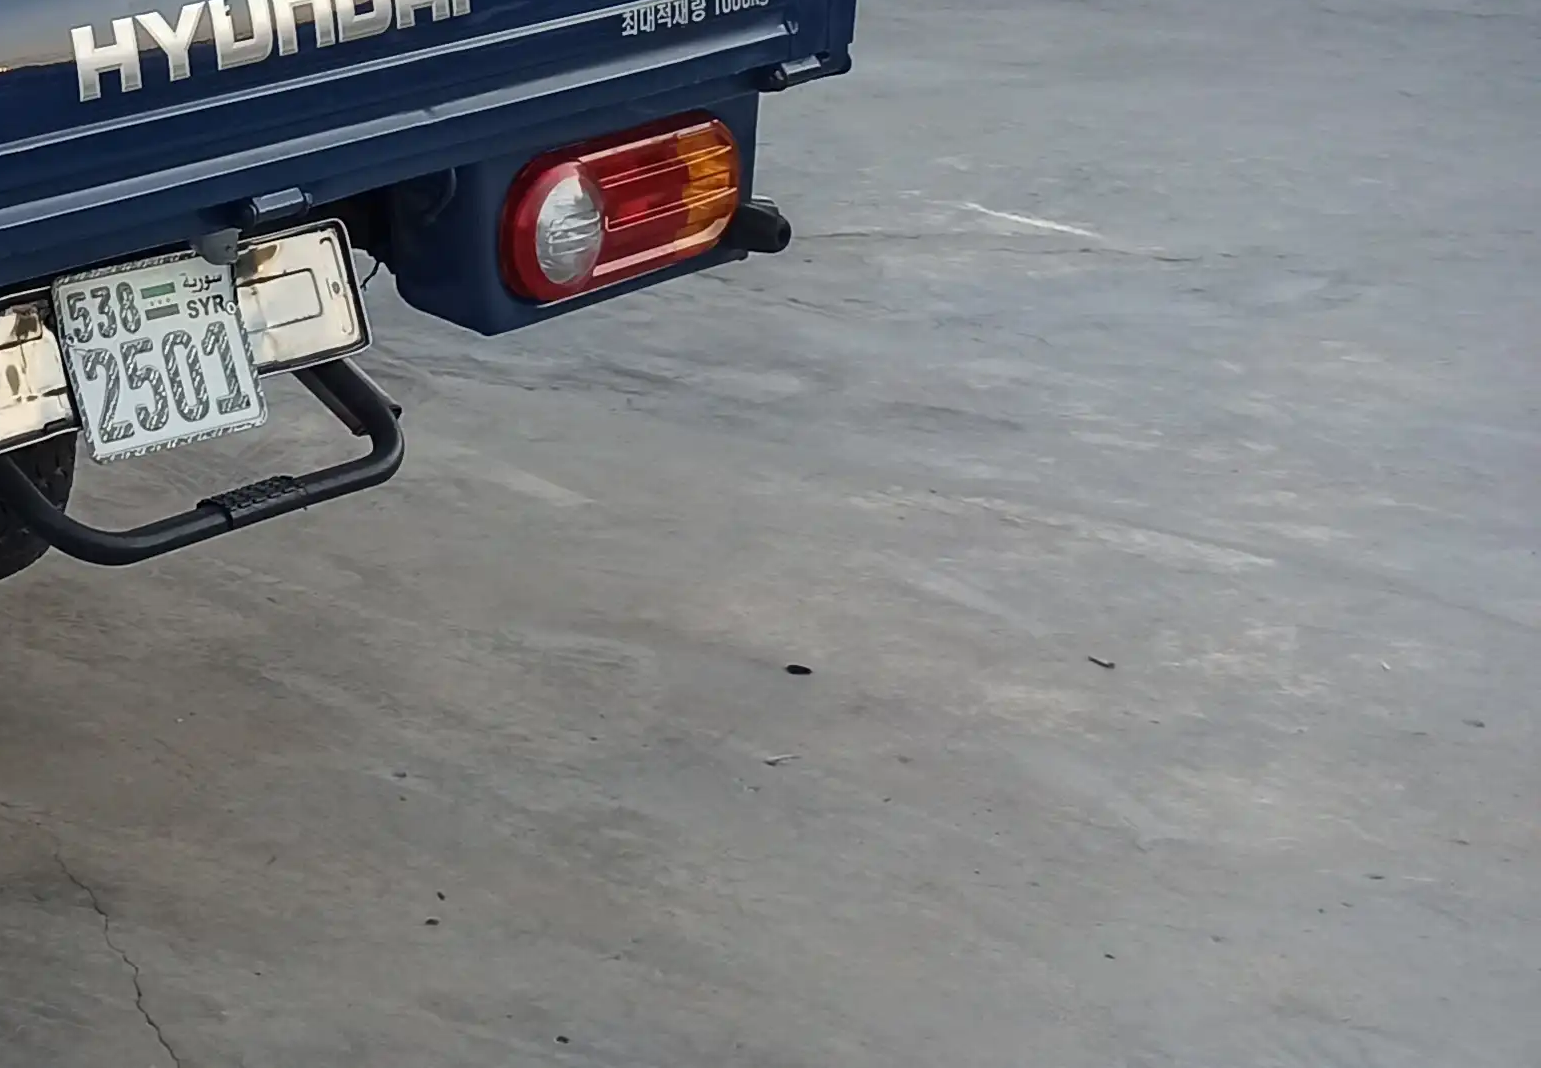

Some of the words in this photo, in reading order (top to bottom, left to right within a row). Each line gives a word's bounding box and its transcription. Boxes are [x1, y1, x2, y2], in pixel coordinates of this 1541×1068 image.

[181, 271, 224, 293] سورية
[65, 281, 142, 344] 538
[185, 293, 226, 320] SYR
[80, 320, 252, 445] 2501
